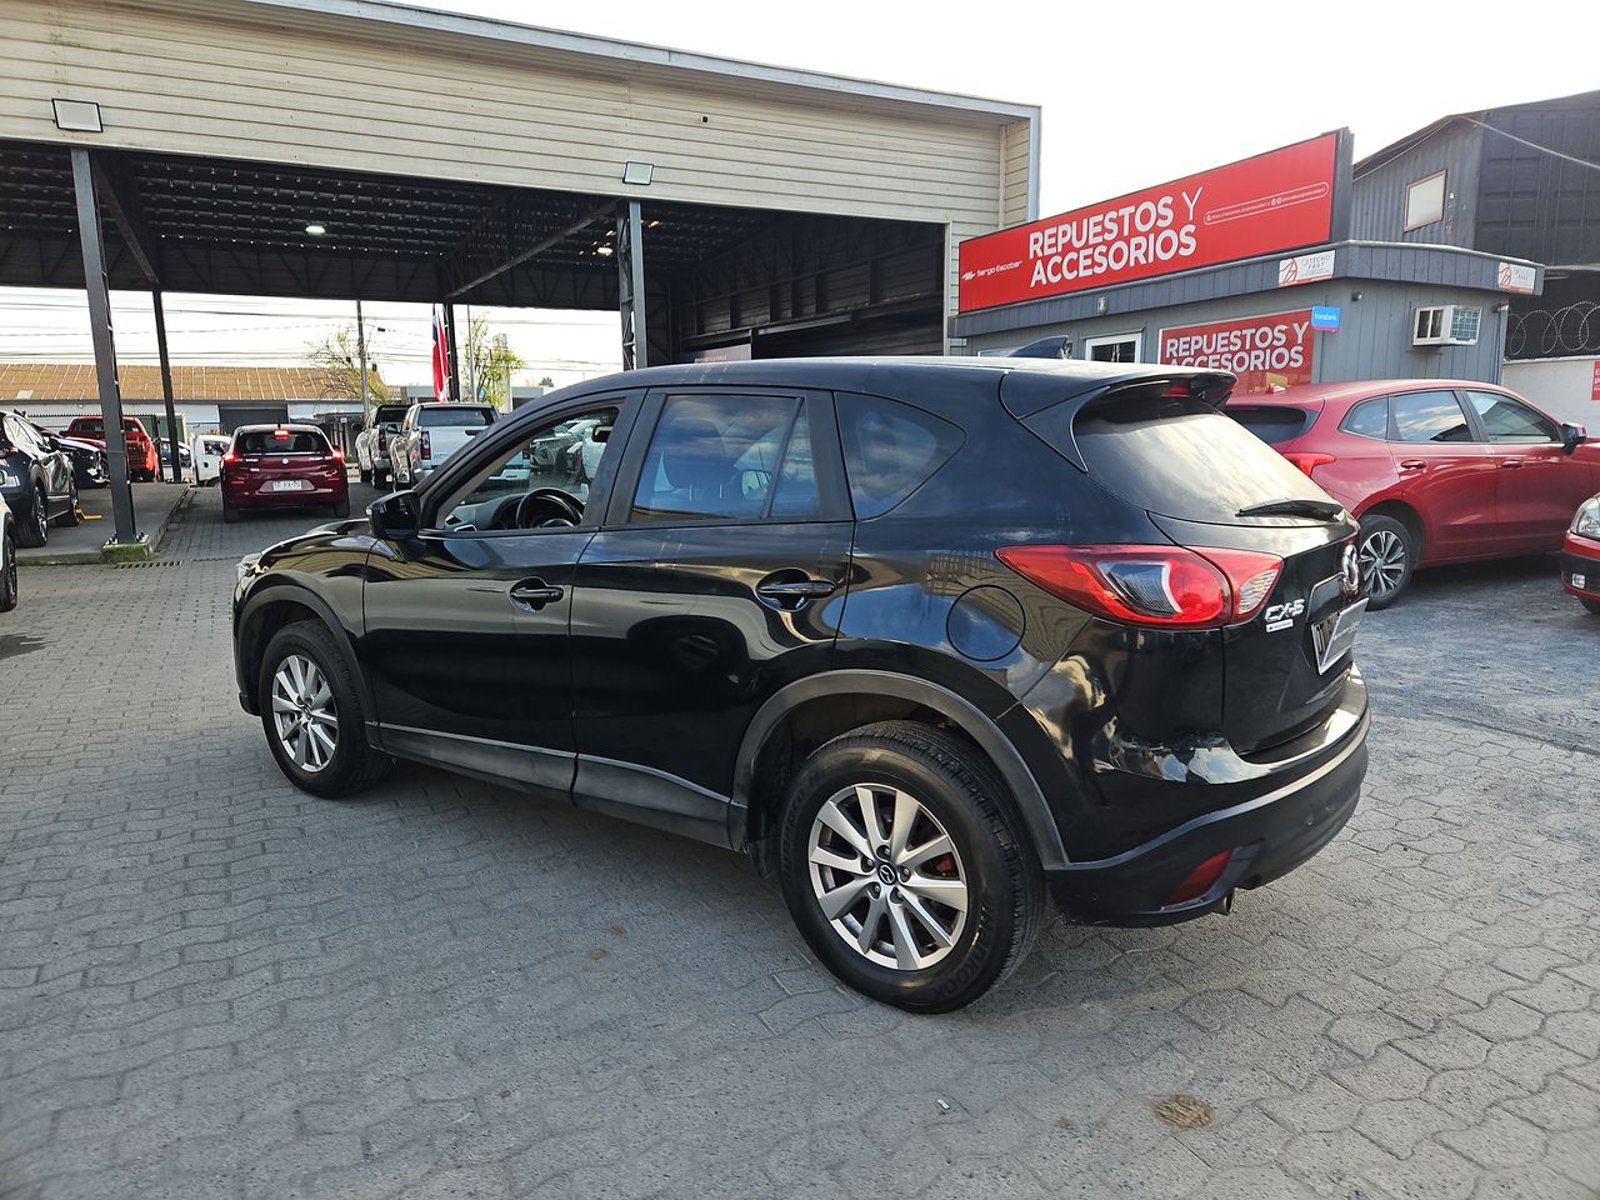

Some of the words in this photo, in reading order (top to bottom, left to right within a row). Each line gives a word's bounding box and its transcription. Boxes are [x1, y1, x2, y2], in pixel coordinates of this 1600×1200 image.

[1029, 196, 1174, 260] REPUESTOS
[1182, 187, 1204, 221] Y
[1029, 224, 1197, 288] ACCESORIOS
[1166, 324, 1290, 358] REPUESTOS
[1293, 321, 1310, 344] Y
[1265, 598, 1306, 622] CX-5
